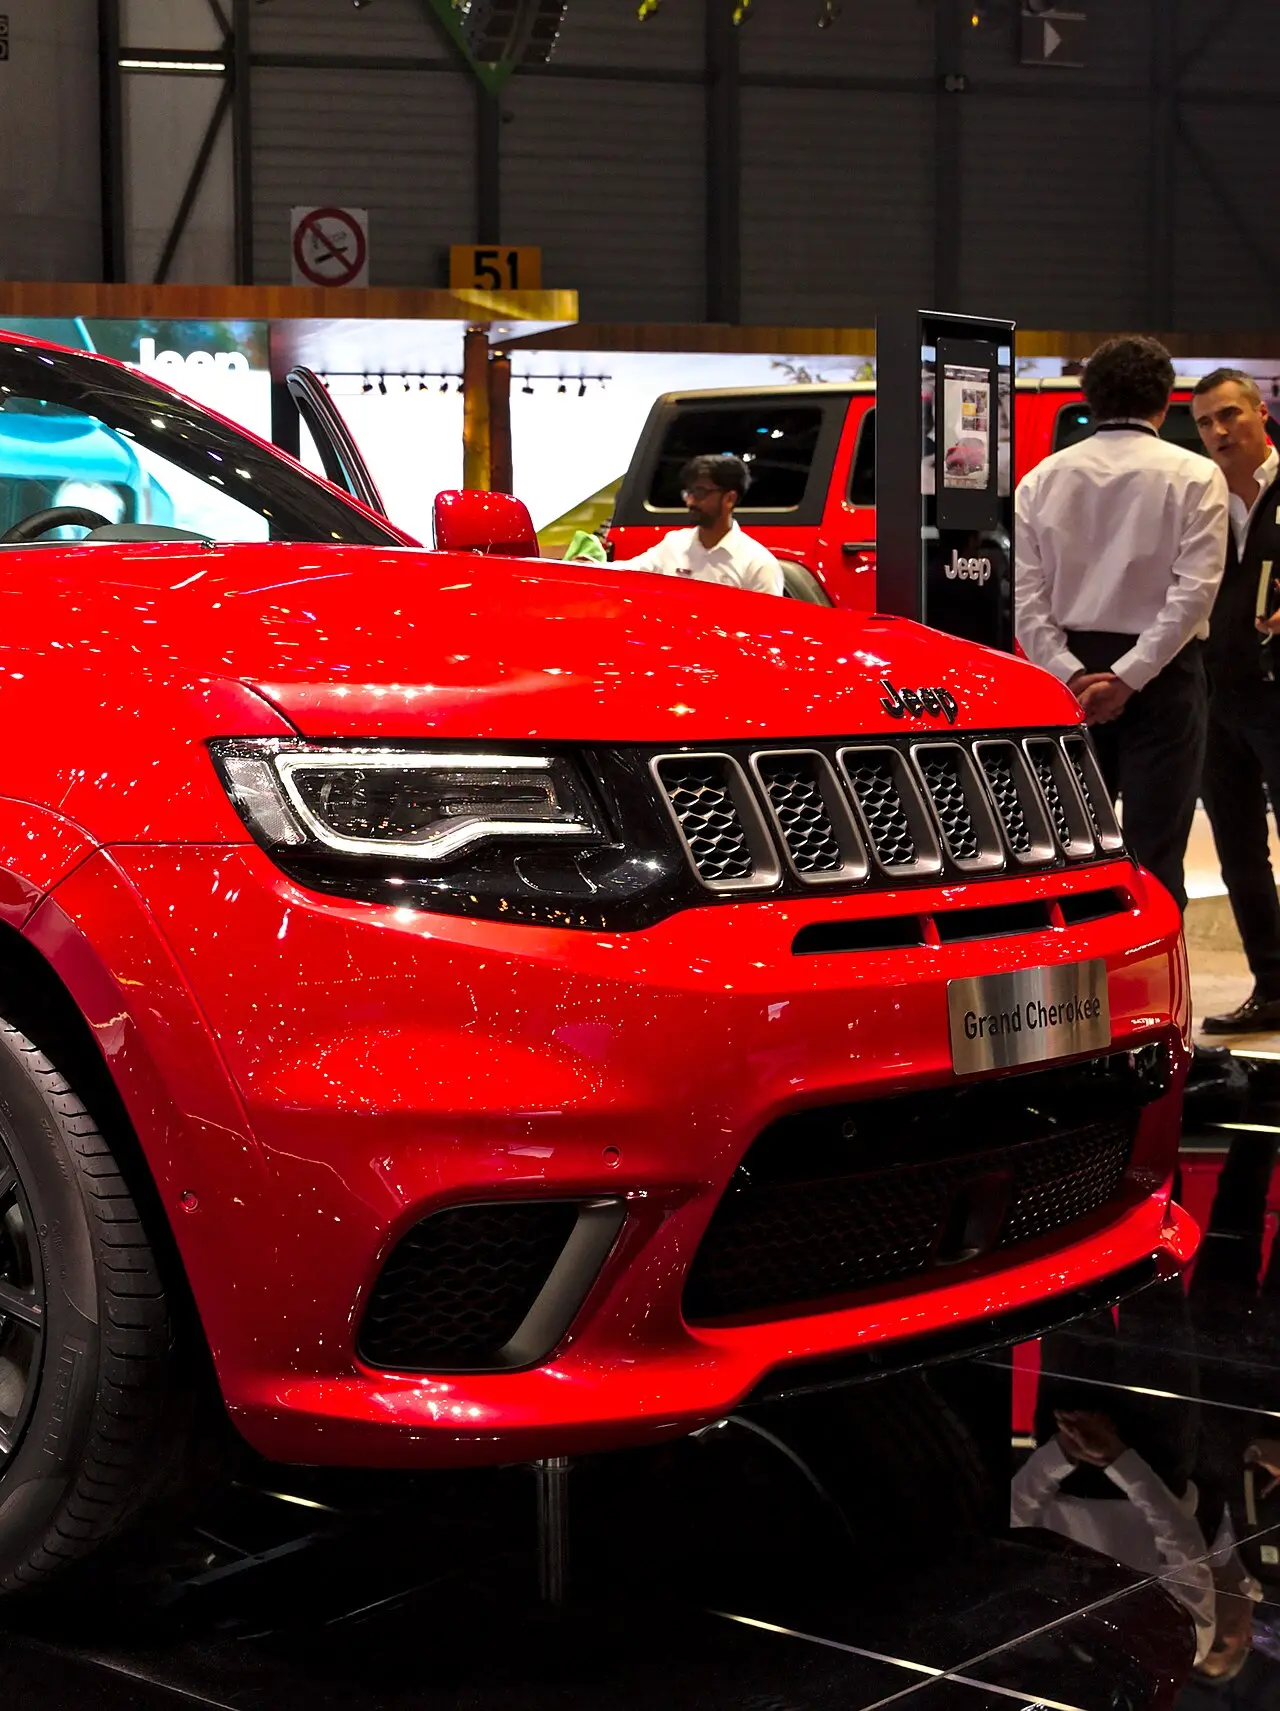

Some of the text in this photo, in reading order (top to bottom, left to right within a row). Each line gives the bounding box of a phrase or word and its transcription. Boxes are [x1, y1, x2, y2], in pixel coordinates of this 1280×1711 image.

[473, 251, 519, 290] 51
[944, 549, 991, 586] Jeep
[880, 679, 959, 725] Jeep
[963, 995, 1101, 1040] Grand Cherokee
